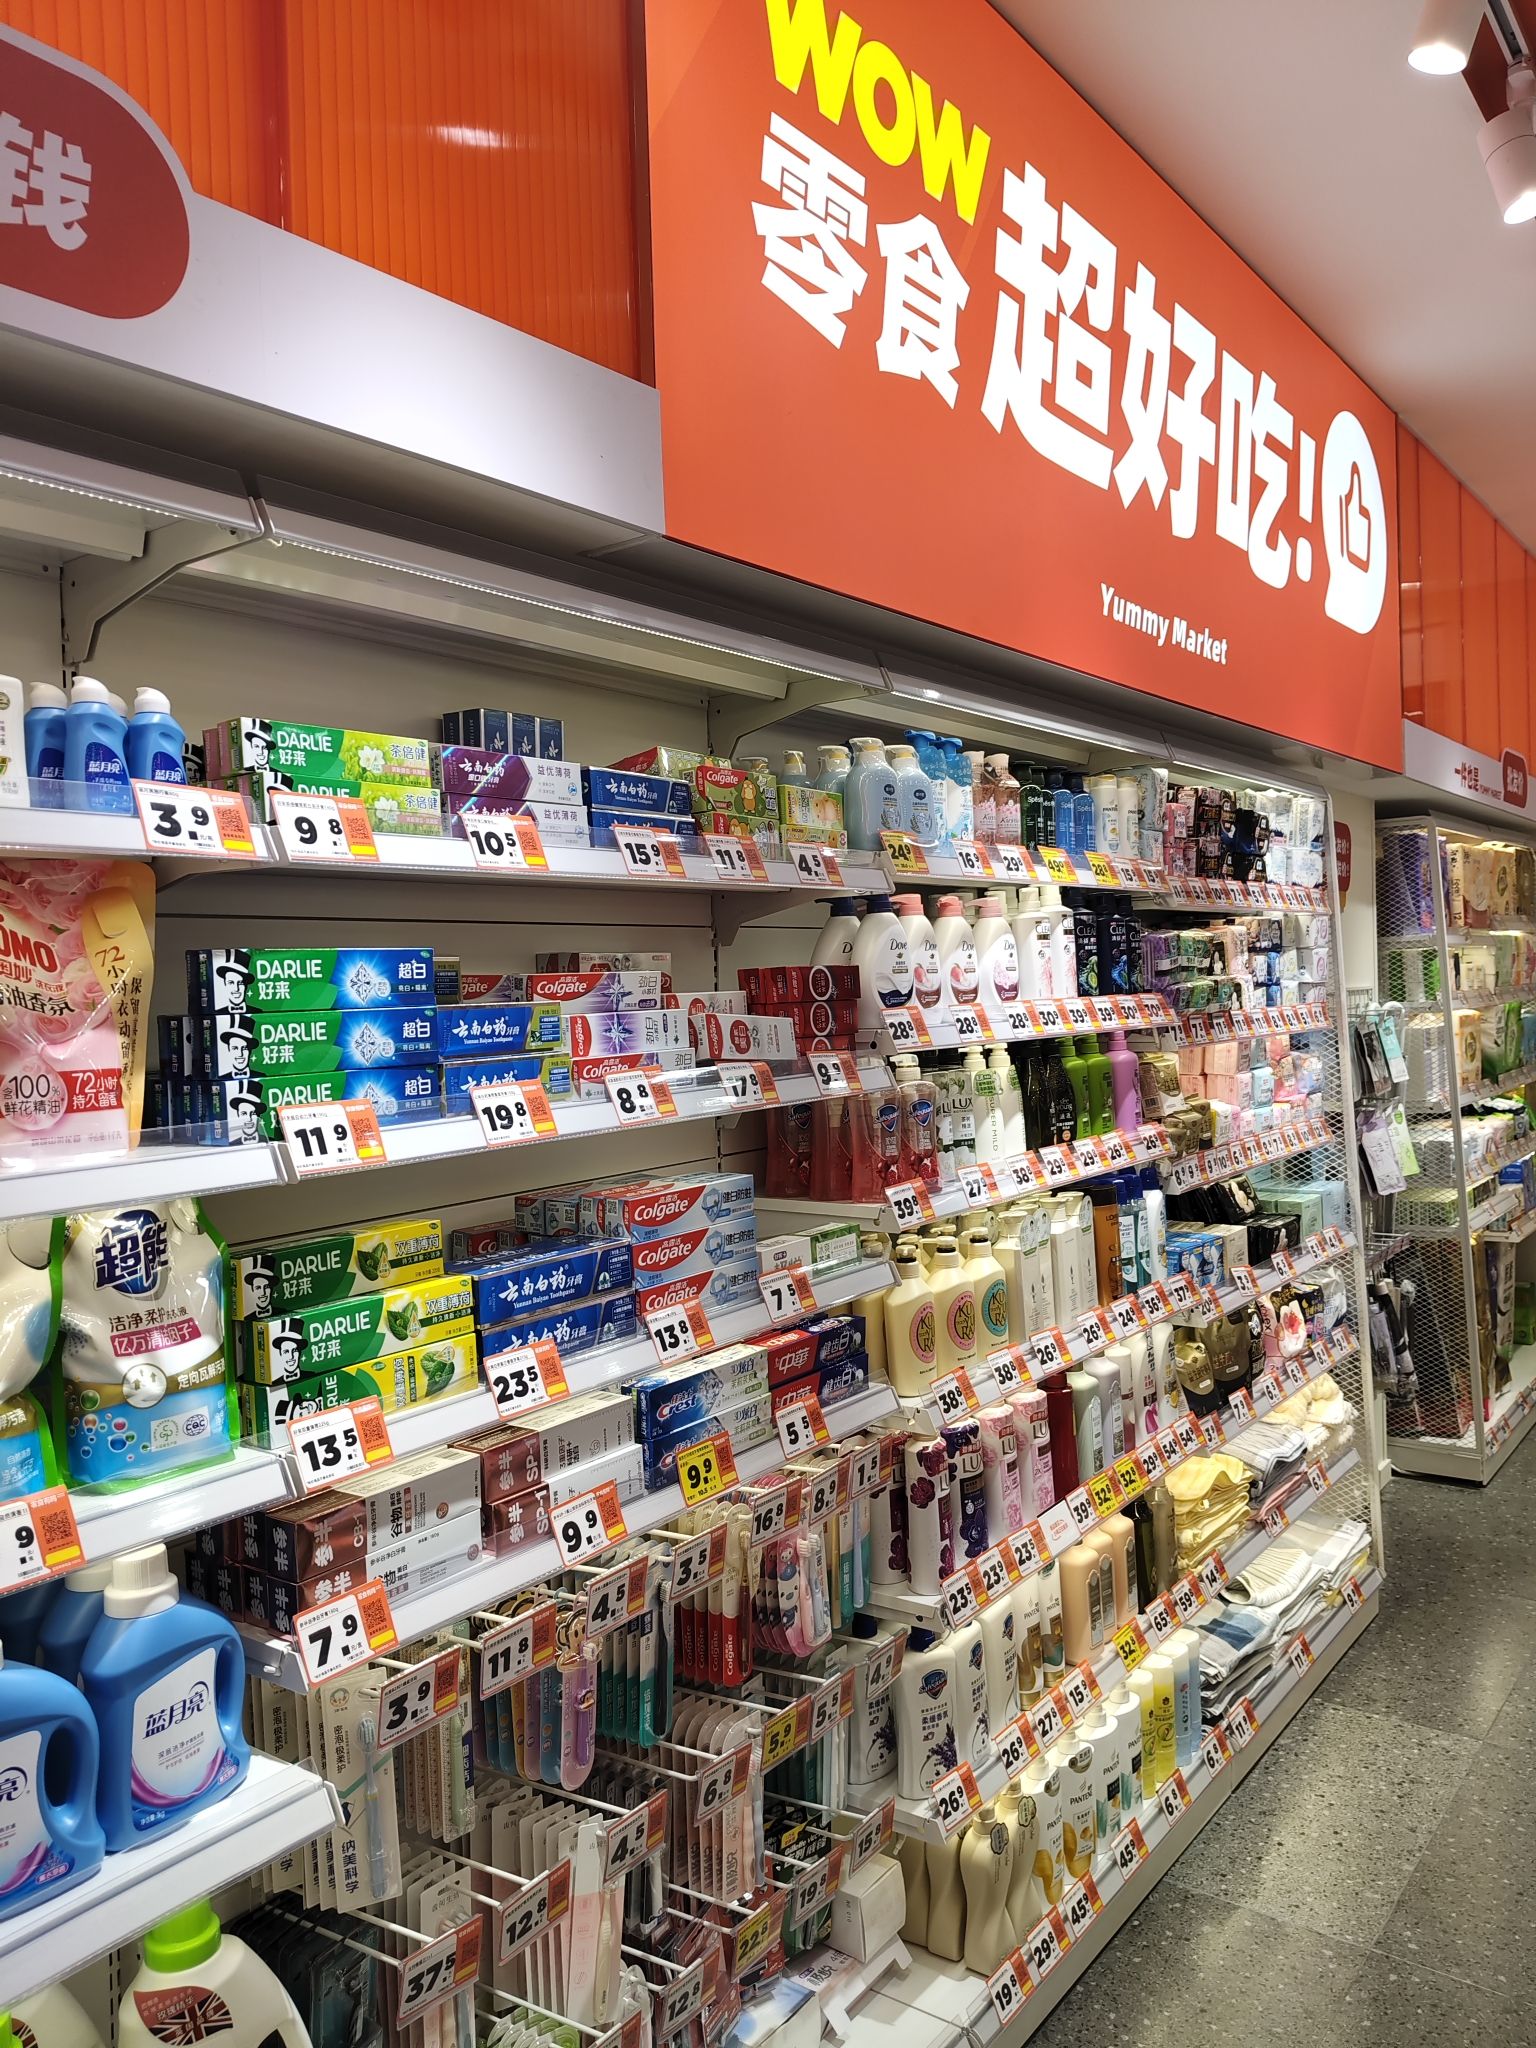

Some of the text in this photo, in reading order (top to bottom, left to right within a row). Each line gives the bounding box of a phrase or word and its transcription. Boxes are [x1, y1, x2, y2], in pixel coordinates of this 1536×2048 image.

[766, 0, 991, 226] WOW
[751, 111, 970, 409] 零食
[1101, 583, 1228, 664] Yummy Market
[277, 730, 333, 753] DARLIE
[390, 744, 428, 761] 茶倍健
[88, 757, 123, 774] 蓝月亮
[279, 748, 307, 767] 好来
[459, 757, 505, 777] 云南白药
[155, 768, 183, 784] 蓝月亮
[537, 764, 572, 780] 益优薄荷
[706, 770, 739, 786] Colgate
[404, 794, 438, 811] 茶倍健
[543, 808, 578, 823] 益优薄荷
[151, 802, 209, 841] 3.9
[294, 816, 343, 847] 9.8
[470, 830, 517, 858] 10.5
[624, 842, 661, 867] 15.9
[715, 849, 745, 871] 11.8
[798, 853, 821, 877] 4.5
[959, 851, 980, 869] 16.9
[1003, 856, 1023, 872] 29.8
[95, 946, 124, 967] 72
[890, 938, 907, 951] Dove
[257, 959, 322, 979] DARLIE
[398, 960, 427, 979] 超白
[638, 975, 658, 988] 劲白
[258, 980, 290, 1000] 好来
[536, 978, 589, 995] Colgate
[956, 1015, 978, 1034] 28.8
[1008, 1012, 1029, 1029] 28.8
[1038, 1010, 1059, 1027] 30.9
[1069, 1008, 1088, 1026] 39.9
[1098, 1006, 1117, 1023] 39.9
[260, 1021, 327, 1044] DARLIE
[402, 1018, 431, 1039] 超白
[645, 1016, 656, 1045] 劲白
[710, 1017, 719, 1058] Colgate
[889, 1020, 914, 1040] 28.8
[262, 1045, 295, 1065] 好来
[71, 1073, 118, 1098] 72小时
[404, 1077, 432, 1096] 超白
[816, 1062, 842, 1085] 9.9
[4, 1098, 61, 1117] 鲜花精油
[72, 1094, 117, 1110] 持久留香
[268, 1083, 332, 1108] DARLIE
[616, 1083, 649, 1115] 8.8
[952, 1097, 973, 1109] LUX
[481, 1101, 527, 1132] 19.8
[293, 1123, 348, 1157] 11.9
[1109, 1142, 1124, 1160] 26.9
[1012, 1167, 1033, 1186] 38.8
[1049, 1157, 1067, 1175] 29.8
[722, 1187, 752, 1204] 健白防蛀
[965, 1178, 988, 1198] 27.9
[634, 1197, 685, 1222] Colgate
[894, 1195, 919, 1219] 39.8
[395, 1234, 440, 1258] 双重薄荷
[726, 1230, 755, 1248] 健白防蛀
[94, 1220, 170, 1291] 超能
[280, 1249, 342, 1280] DARLIE
[637, 1241, 693, 1267] Colgate
[282, 1282, 312, 1299] 好来
[499, 1265, 583, 1303] 云南白药牙膏
[730, 1270, 758, 1288] 健白防蛀
[425, 1291, 471, 1316] 双重薄荷
[513, 1287, 575, 1309] Yunnan Baiyao Toothpaste
[645, 1284, 699, 1310] Colgate
[770, 1284, 798, 1312] 7.5
[1144, 1294, 1161, 1313] 36.9
[1173, 1283, 1190, 1303] 37.9
[309, 1310, 371, 1343] DARLIE
[1117, 1306, 1136, 1328] 24.9
[653, 1320, 689, 1353] 13.8
[1082, 1321, 1101, 1345] 26.9
[311, 1345, 341, 1364] 好来
[1037, 1343, 1057, 1366] 26.9
[493, 1365, 540, 1405] 23.5
[994, 1364, 1017, 1386] 38.8
[657, 1394, 698, 1420] Crest
[938, 1385, 964, 1414] 38.8
[185, 1419, 208, 1430] CQC
[786, 1415, 810, 1446] 5.5
[1179, 1426, 1194, 1448] 54.9
[301, 1428, 358, 1472] 13.5
[527, 1439, 539, 1482] SP-1
[1162, 1440, 1178, 1461] 54.9
[499, 1450, 514, 1491] 参半
[686, 1458, 713, 1489] 9.9
[857, 1455, 878, 1488] 1.5
[1142, 1452, 1159, 1475] 29.9
[1119, 1466, 1137, 1488] 32.8
[813, 1480, 836, 1513] 8.9
[1094, 1483, 1112, 1508] 32.8
[508, 1502, 525, 1544] 参半
[535, 1490, 549, 1535] SP-1
[754, 1503, 784, 1533] 16.8
[1072, 1497, 1092, 1525] 39.9
[561, 1509, 599, 1553] 9.9
[1014, 1537, 1036, 1568] 23.5
[676, 1552, 709, 1588] 3.5
[982, 1559, 1005, 1590] 23.9
[1205, 1564, 1219, 1587] 14.9
[314, 1571, 353, 1605] 参半
[948, 1586, 974, 1615] 23.5
[1178, 1587, 1195, 1614] 59.8
[592, 1583, 626, 1622] 4.5
[1153, 1607, 1170, 1633] 65.9
[308, 1614, 359, 1669] 7.9
[711, 1629, 719, 1673] Colgate
[726, 1633, 734, 1676] Colgate
[1119, 1634, 1136, 1661] 32.8
[488, 1636, 530, 1680] 11.8
[869, 1654, 892, 1687] 4.9
[1068, 1679, 1089, 1707] 15.9
[143, 1688, 208, 1739] 蓝月亮
[386, 1682, 431, 1731] 3.9
[814, 1695, 839, 1728] 5.5
[1037, 1706, 1058, 1737] 27.8
[1234, 1715, 1249, 1740] 11.9
[768, 1723, 791, 1755] 5.9
[1001, 1736, 1024, 1769] 26.9
[1205, 1741, 1220, 1769] 6.8
[703, 1768, 731, 1808] 6.8
[938, 1787, 965, 1821] 26.9
[1163, 1787, 1179, 1816] 6.8
[610, 1821, 646, 1867] 4.5
[856, 1825, 881, 1859] 15.8
[1118, 1838, 1136, 1870] 45.9
[340, 1839, 360, 1894] 纳美科学
[800, 1874, 827, 1909] 19.8
[1070, 1891, 1089, 1927] 45.9
[506, 1900, 548, 1949] 12.8
[1033, 1931, 1056, 1969] 29.8
[405, 1953, 456, 2004] 37.5
[668, 1981, 701, 2023] 12.8
[993, 1974, 1018, 2012] 19.8
[157, 1995, 194, 2021] 玫瑰精华
